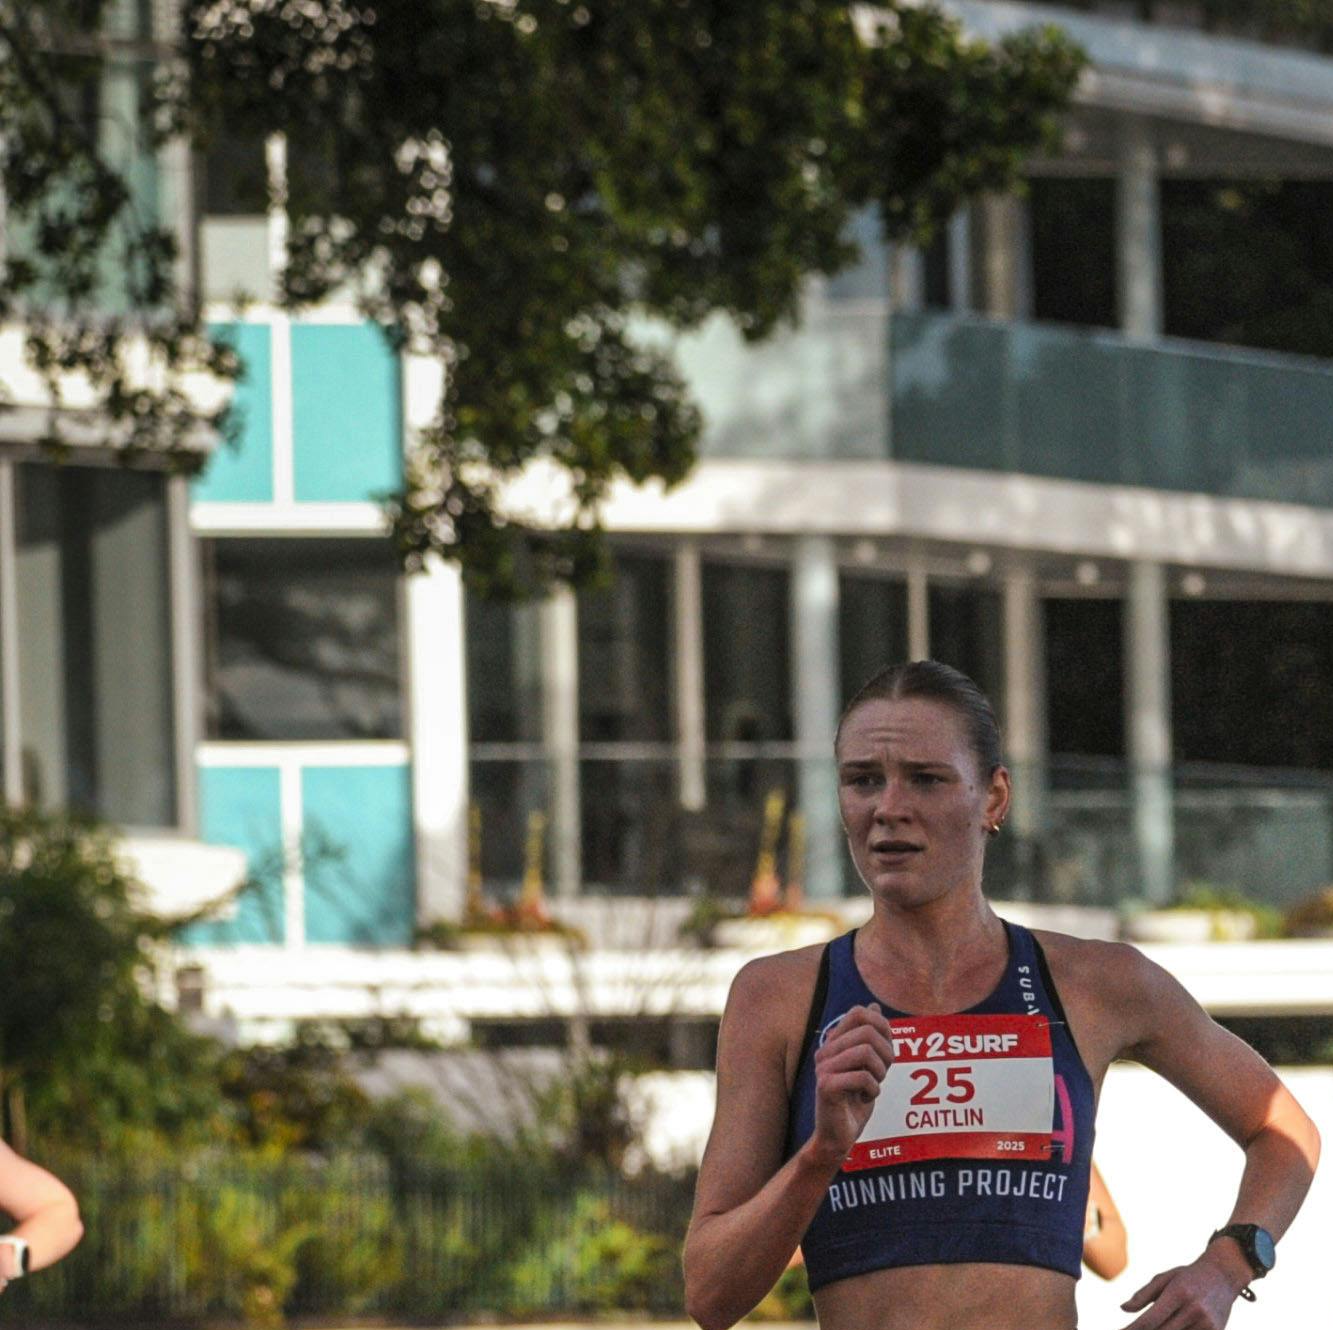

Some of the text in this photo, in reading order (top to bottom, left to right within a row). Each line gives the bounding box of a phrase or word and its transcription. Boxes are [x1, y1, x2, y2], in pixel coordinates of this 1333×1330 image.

[891, 1026, 916, 1035] aren
[892, 1032, 1018, 1058] TY2SURF
[909, 1066, 975, 1105] 25
[905, 1108, 983, 1130] CAITLIN
[869, 1146, 901, 1159] ELITE
[996, 1141, 1025, 1151] 2025
[829, 1169, 1067, 1212] RUNNING PROJECT
